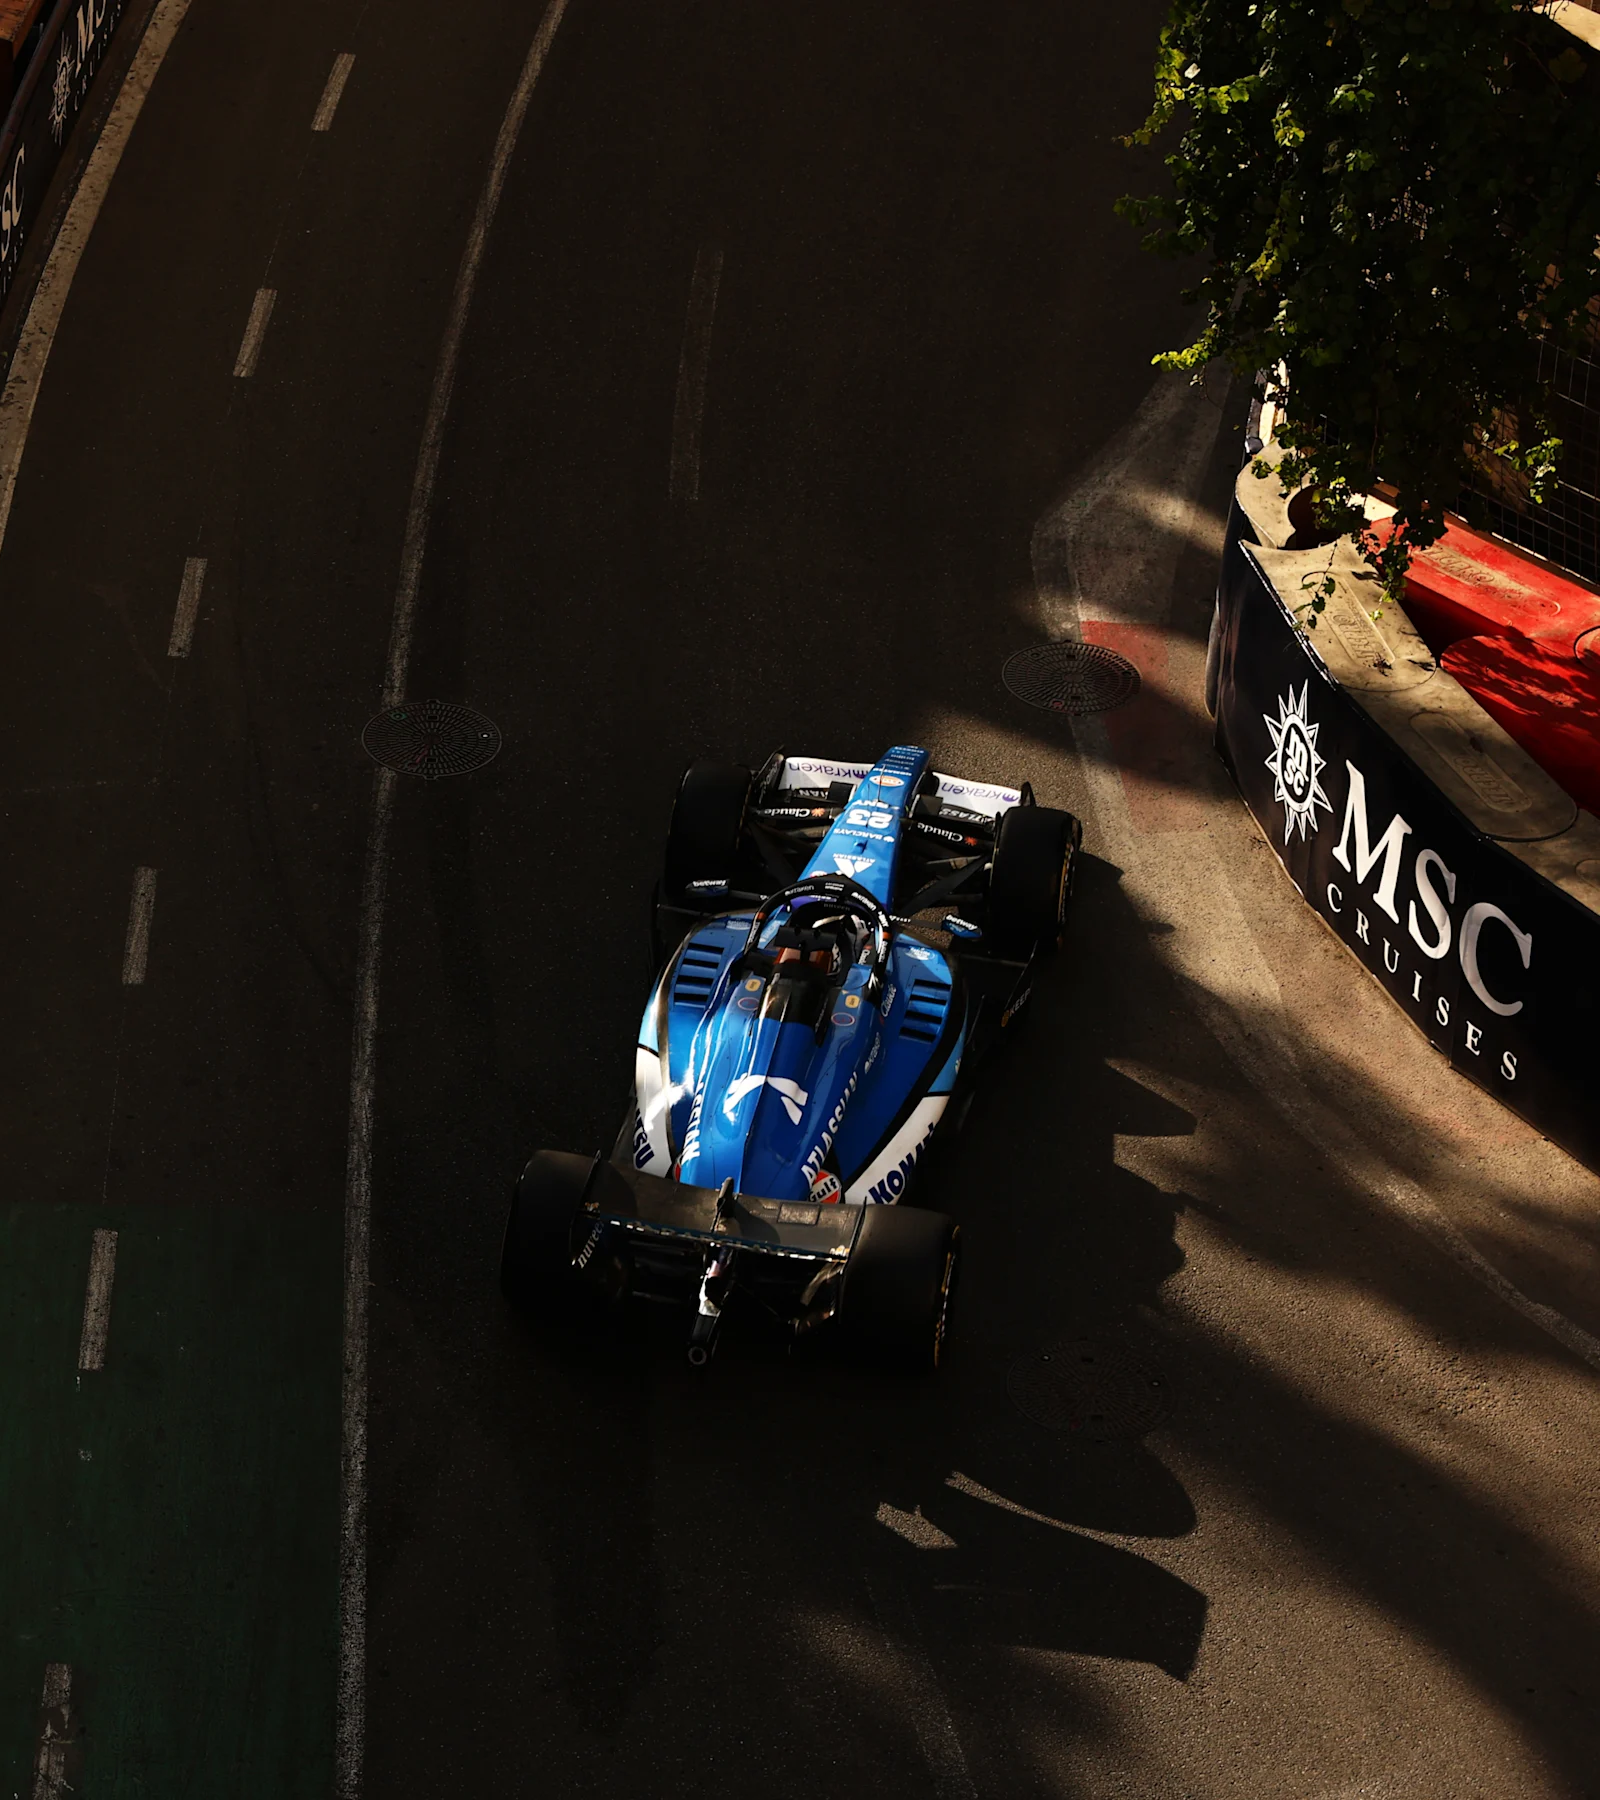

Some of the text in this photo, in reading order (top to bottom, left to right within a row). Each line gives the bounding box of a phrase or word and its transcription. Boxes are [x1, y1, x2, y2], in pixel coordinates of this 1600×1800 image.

[789, 762, 851, 778] kraken
[941, 782, 1001, 802] kraken
[764, 807, 810, 818] Claude
[846, 808, 893, 829] 23
[833, 828, 883, 840] BARCLAYS
[917, 821, 964, 843] Claude
[1331, 758, 1532, 1017] MSC
[1326, 881, 1518, 1081] CRUISES
[808, 1177, 838, 1203] Gulf
